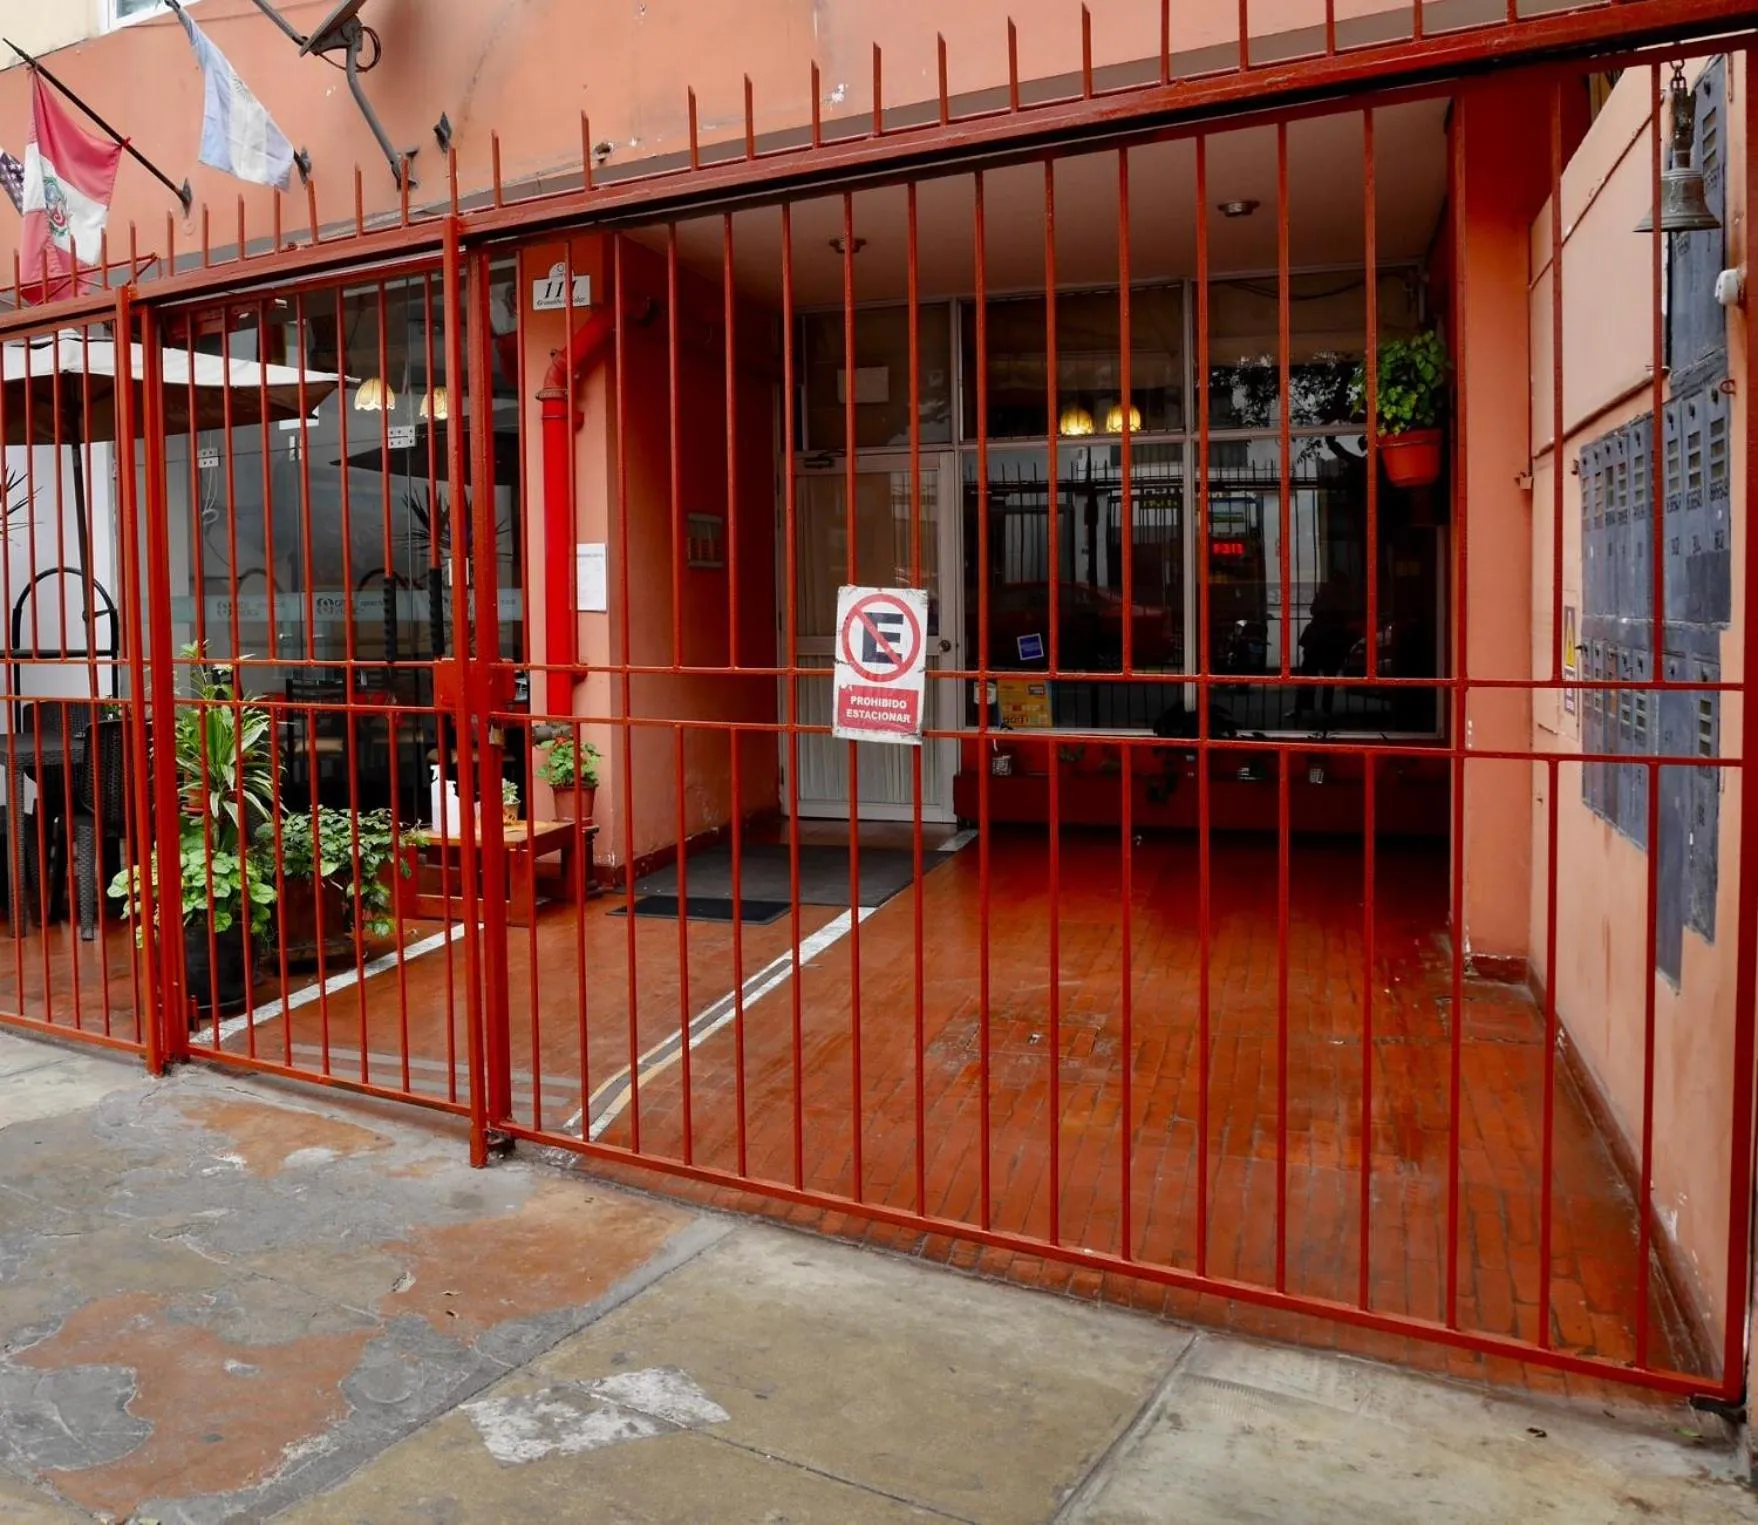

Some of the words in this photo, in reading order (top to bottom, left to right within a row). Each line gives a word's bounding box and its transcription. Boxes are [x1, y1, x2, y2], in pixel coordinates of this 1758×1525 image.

[862, 612, 904, 664] E
[850, 695, 907, 709] PROHIBIDO
[846, 708, 911, 724] ESTACIONAR
